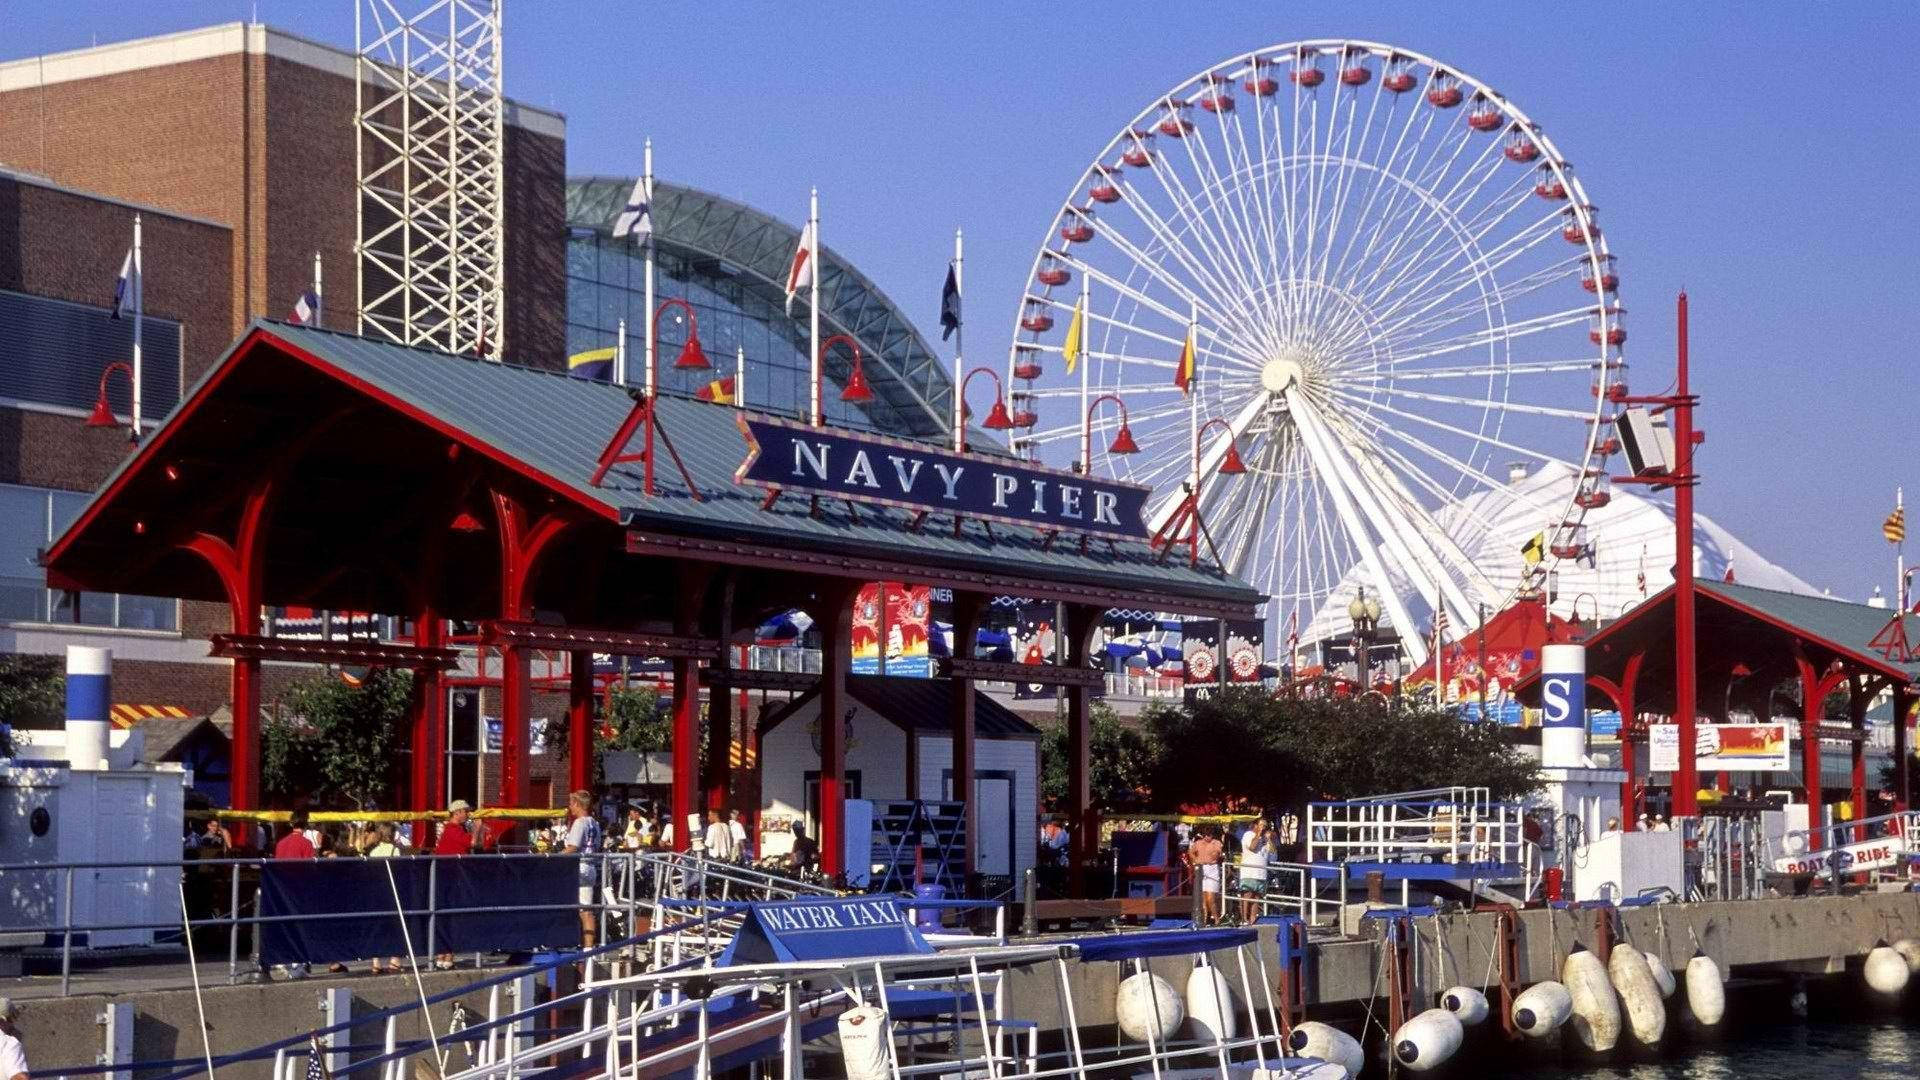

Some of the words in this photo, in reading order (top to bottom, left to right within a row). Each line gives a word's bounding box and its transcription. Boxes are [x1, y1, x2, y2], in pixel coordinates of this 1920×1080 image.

[791, 438, 964, 500] NAVY
[992, 472, 1121, 526] PIER
[1544, 678, 1570, 722] S
[1788, 857, 1824, 873] BOAT
[1856, 846, 1892, 864] RIDE
[759, 905, 843, 931] WATER
[842, 901, 901, 927] TAXI
